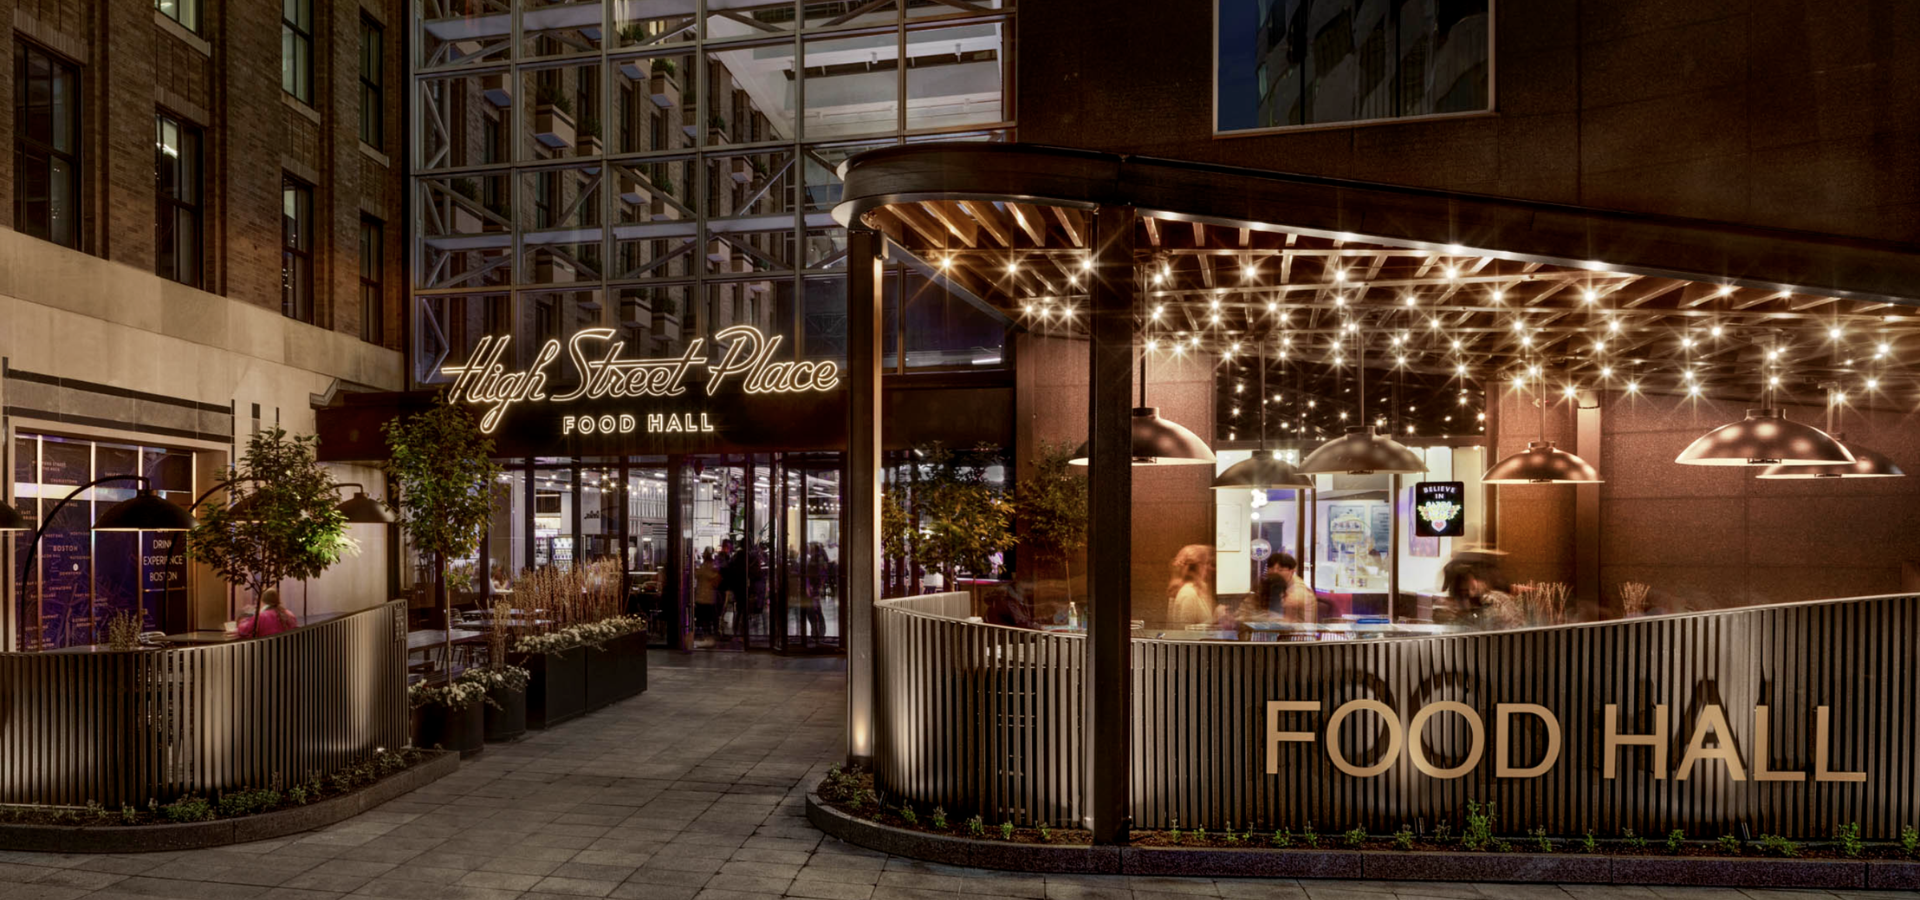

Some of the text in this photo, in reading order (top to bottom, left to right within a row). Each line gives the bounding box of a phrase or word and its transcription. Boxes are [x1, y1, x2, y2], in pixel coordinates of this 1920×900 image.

[440, 324, 840, 434] High Street Place
[562, 412, 714, 435] FOOD HALL
[153, 539, 172, 550] DRIN
[1266, 699, 1867, 782] FOOD HALL
